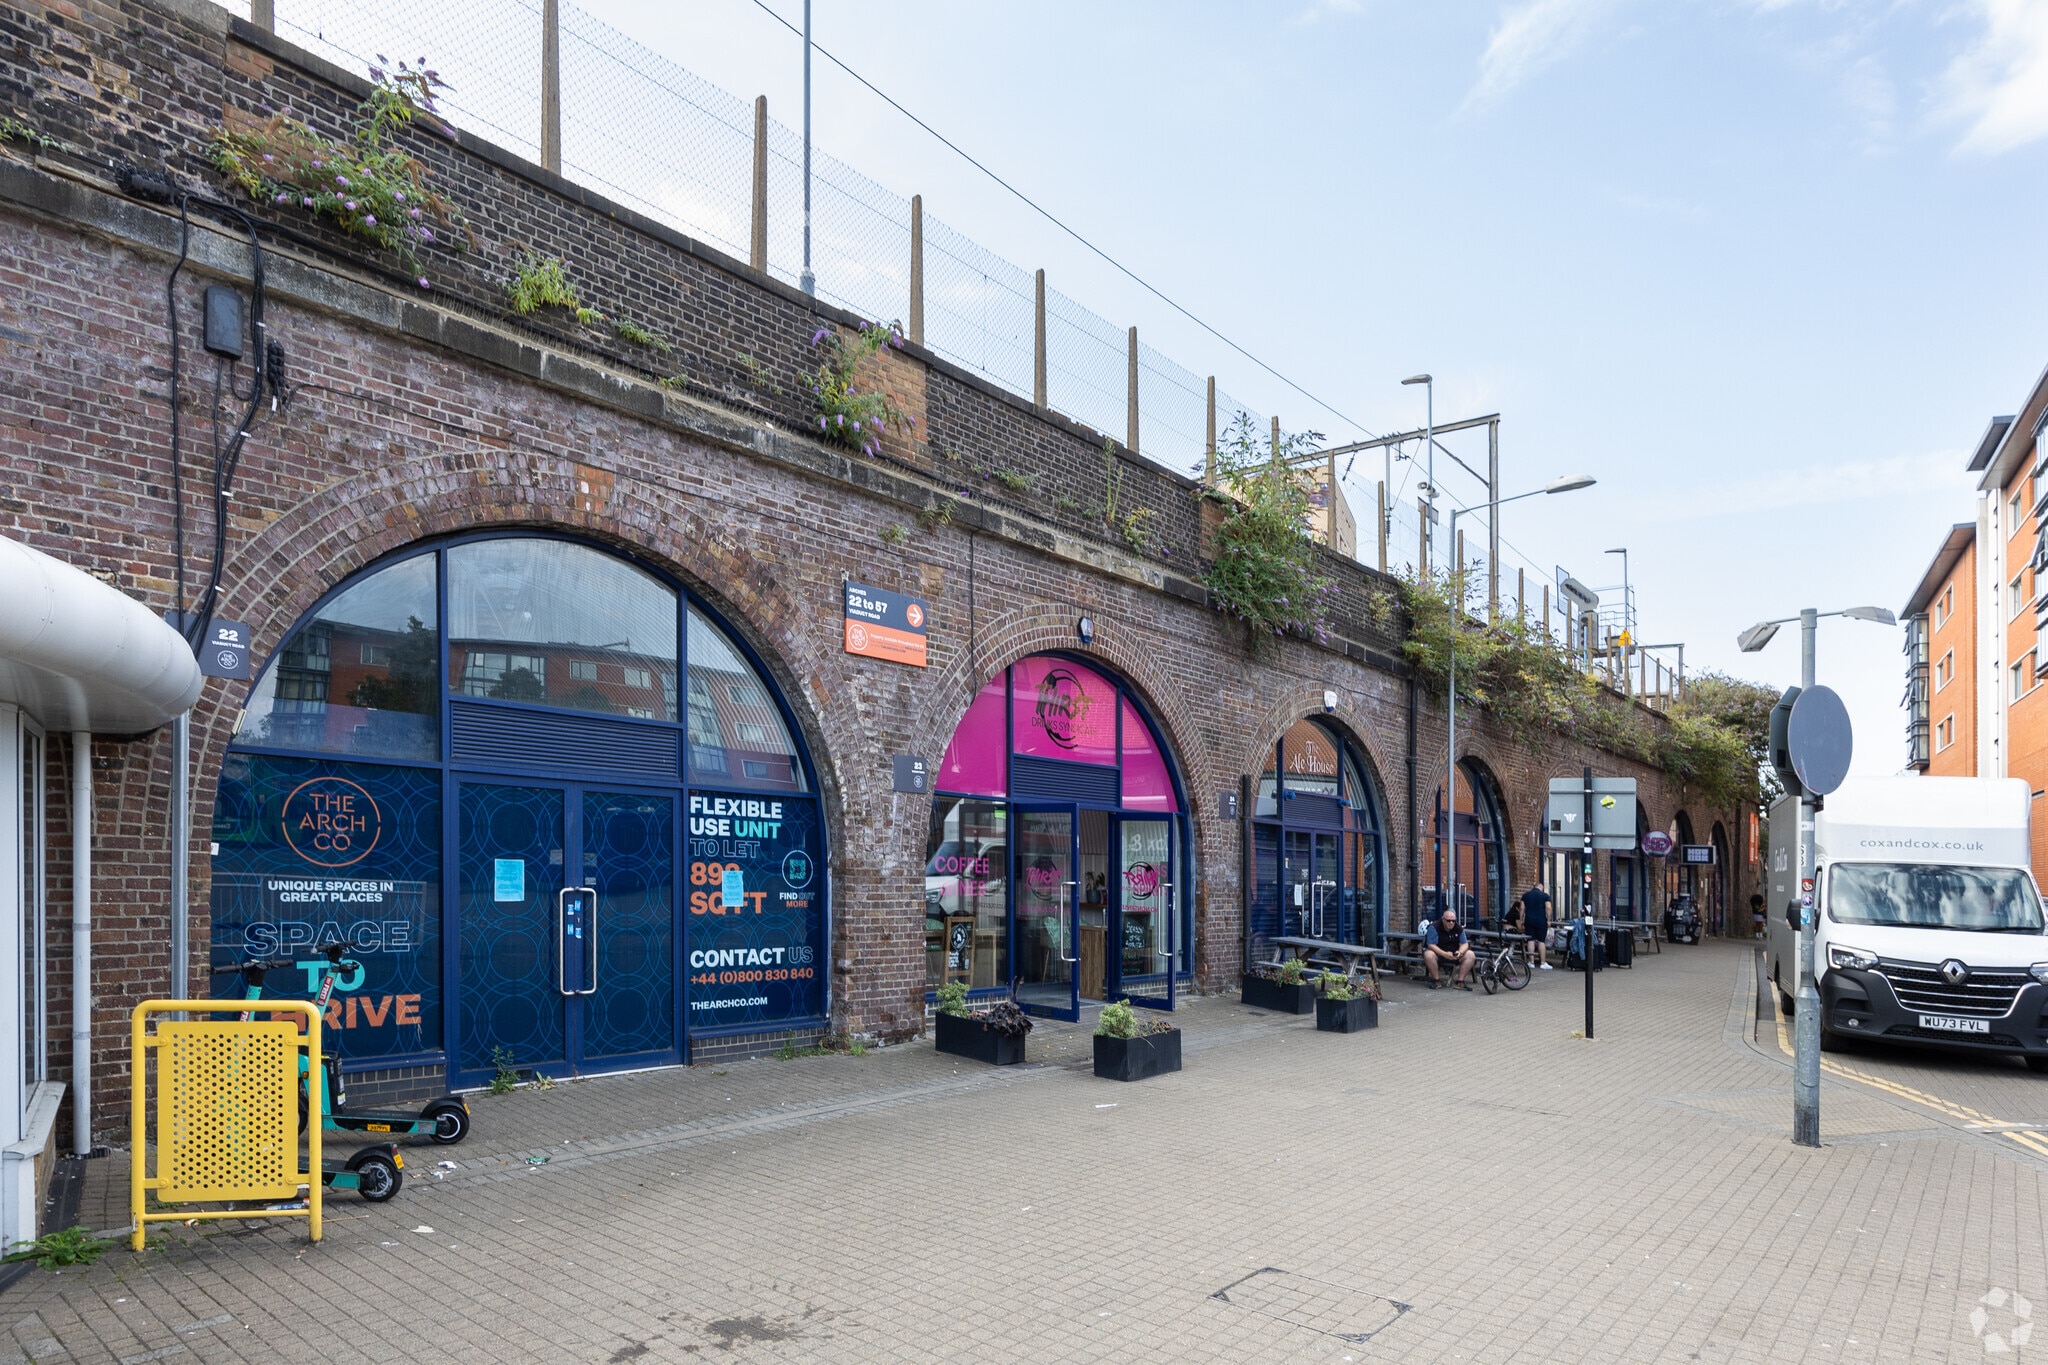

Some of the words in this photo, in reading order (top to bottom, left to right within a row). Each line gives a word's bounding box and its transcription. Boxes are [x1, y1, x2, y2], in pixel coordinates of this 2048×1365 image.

[849, 587, 866, 596] ARCHES
[849, 595, 862, 608] 22
[863, 598, 874, 610] to
[875, 600, 888, 614] 57
[849, 608, 868, 617] VIADUCT
[868, 612, 880, 620] ROAD
[219, 628, 238, 642] 22
[914, 762, 922, 770] 23
[1307, 755, 1334, 774] House
[309, 793, 355, 813] THE
[690, 796, 782, 819] FLEXIBLE
[299, 812, 365, 832] ARCH
[690, 817, 730, 836] USE
[735, 820, 781, 839] UNIT
[314, 833, 350, 851] CO
[690, 838, 719, 857] TO
[723, 840, 760, 858] LET
[1860, 838, 1984, 851] coxandcox.co.uk
[934, 856, 989, 874] COFFEE
[1025, 866, 1064, 885] THIRST
[268, 880, 324, 892] UNIQUE
[325, 881, 377, 892] SPACES
[379, 882, 393, 892] IN
[280, 892, 328, 902] GREAT
[331, 892, 383, 903] PLACES
[690, 891, 727, 915] SQ
[779, 892, 798, 901] FIND
[786, 900, 808, 908] MORE
[244, 921, 410, 956] SPACE
[690, 947, 785, 968] CONTACT
[788, 946, 814, 964] US
[297, 959, 366, 992] TO
[690, 972, 717, 984] +44
[720, 970, 763, 984] (0)800
[765, 969, 788, 981] 830
[790, 967, 814, 979] 840
[690, 997, 768, 1010] THEARCHCO.COM
[1923, 1018, 1957, 1029] WU73
[1960, 1020, 1984, 1031] FVL
